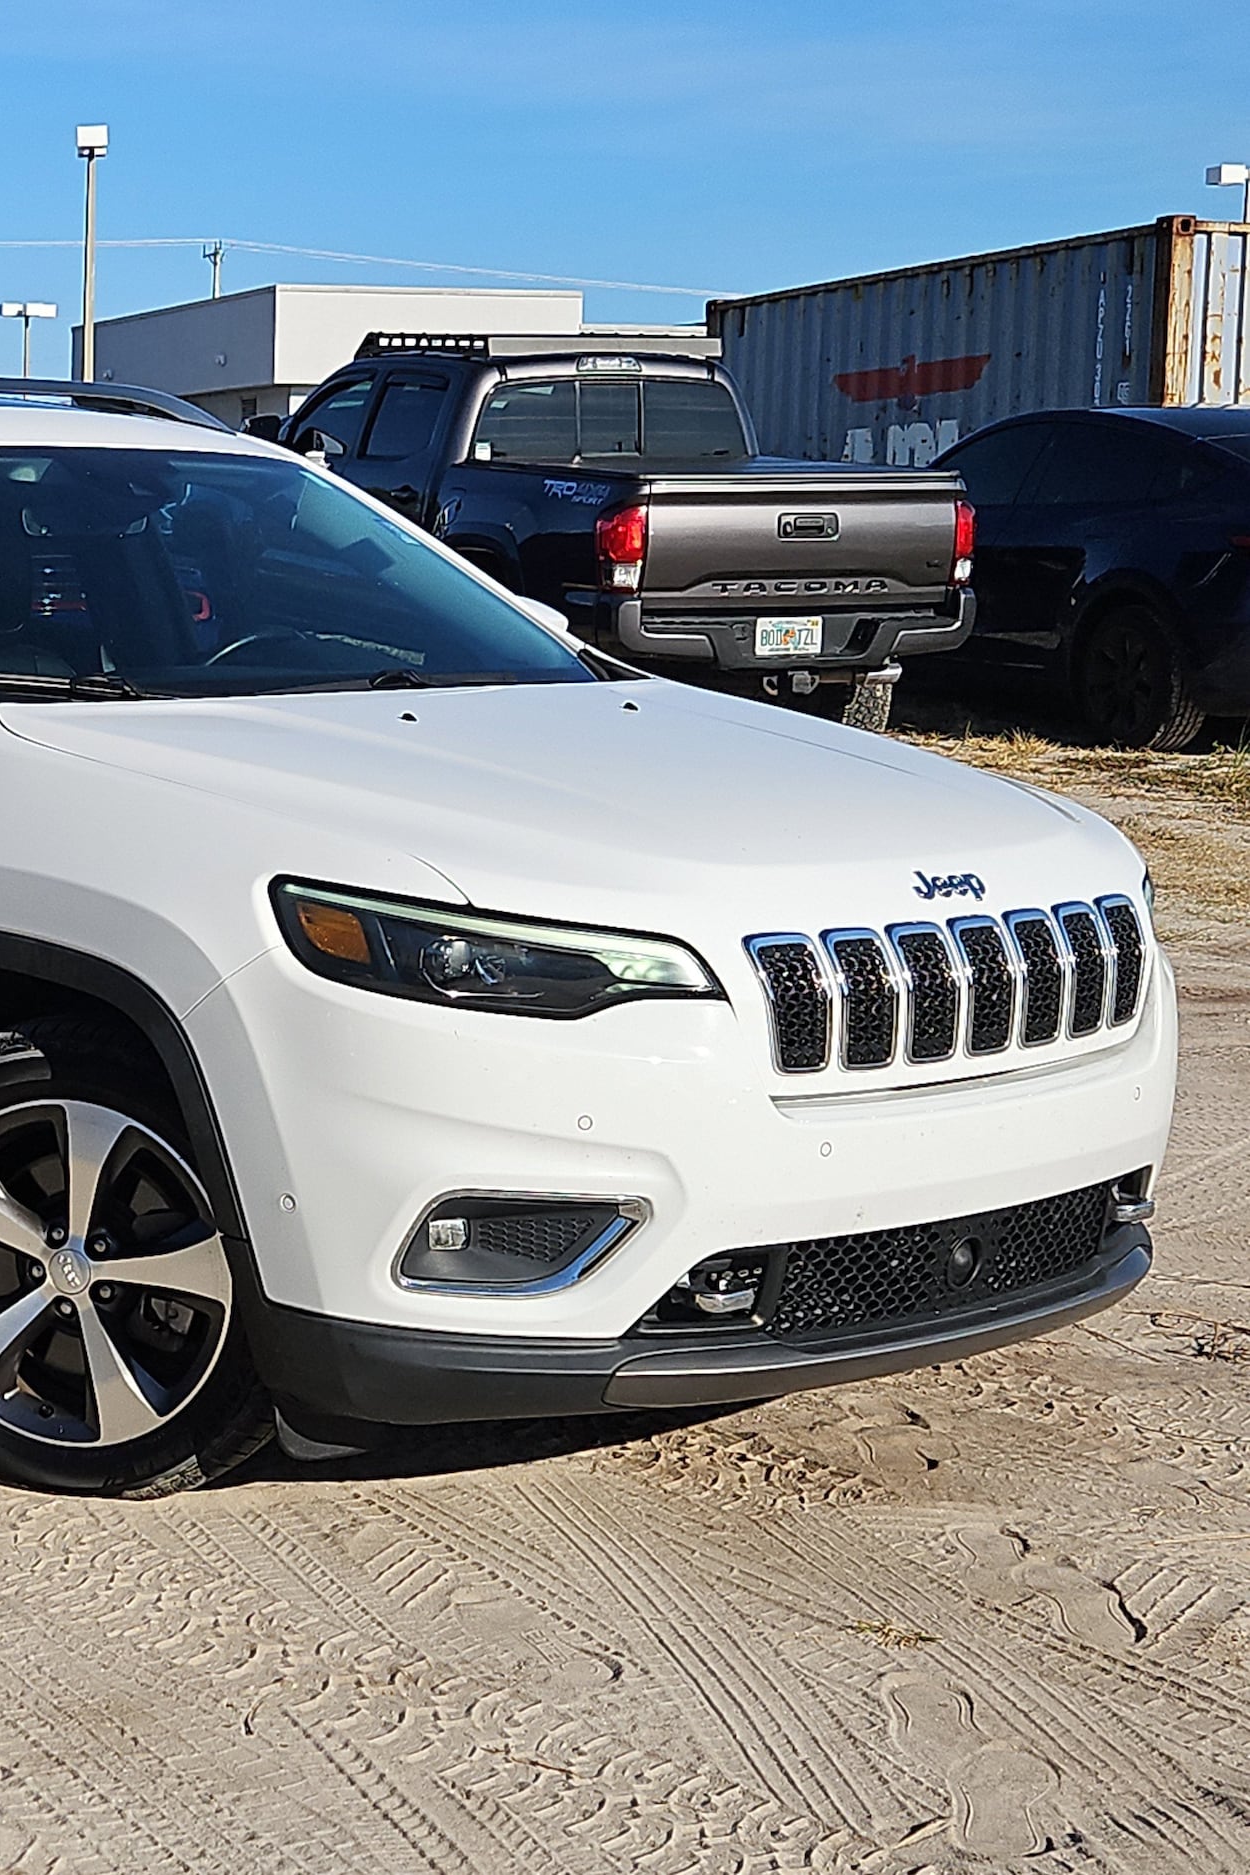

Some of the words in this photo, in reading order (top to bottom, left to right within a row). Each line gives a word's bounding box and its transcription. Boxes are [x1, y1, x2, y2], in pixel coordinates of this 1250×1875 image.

[543, 479, 577, 499] TRD
[712, 579, 888, 596] TACOMA
[912, 870, 985, 901] Jeep
